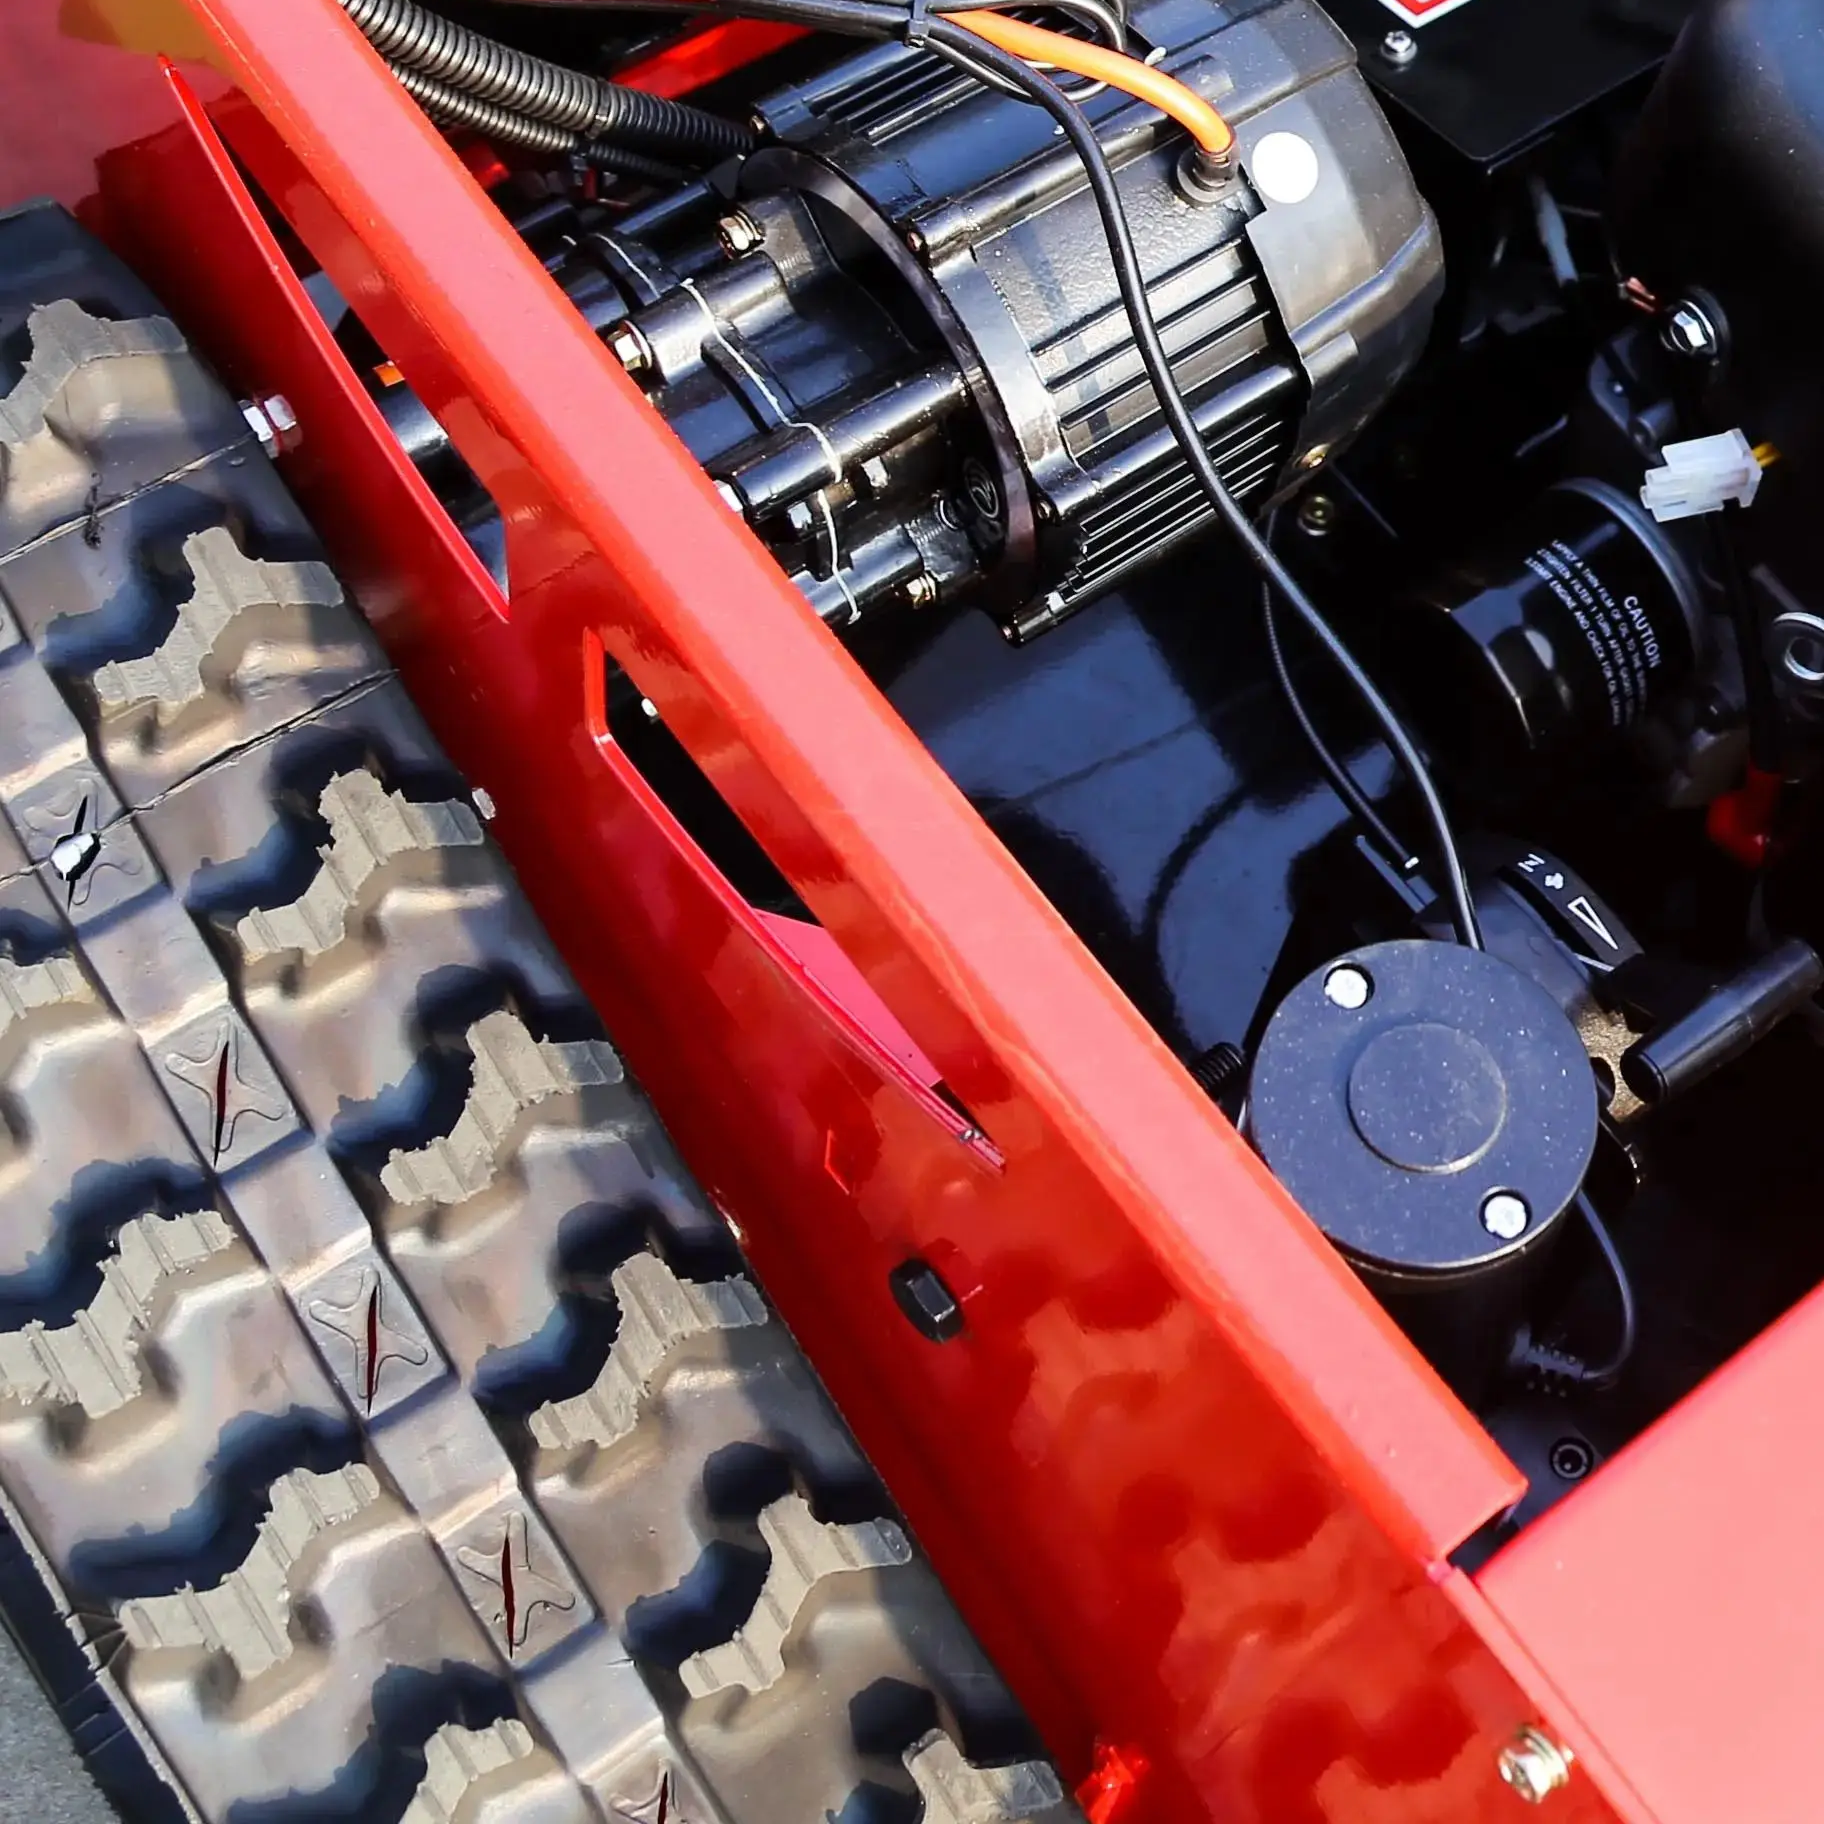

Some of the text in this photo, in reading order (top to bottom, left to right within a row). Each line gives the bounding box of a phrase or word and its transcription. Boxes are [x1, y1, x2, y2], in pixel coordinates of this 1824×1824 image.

[1549, 580, 1577, 609] ENGINE
[1573, 611, 1590, 630] AND
[1586, 630, 1605, 658] CHECK
[1601, 660, 1614, 680] FOR
[1570, 579, 1594, 605] FILTER
[1595, 612, 1612, 637] TURN
[1598, 587, 1615, 608] FILM
[1626, 638, 1636, 652] TO
[1623, 595, 1661, 669] CAUTION
